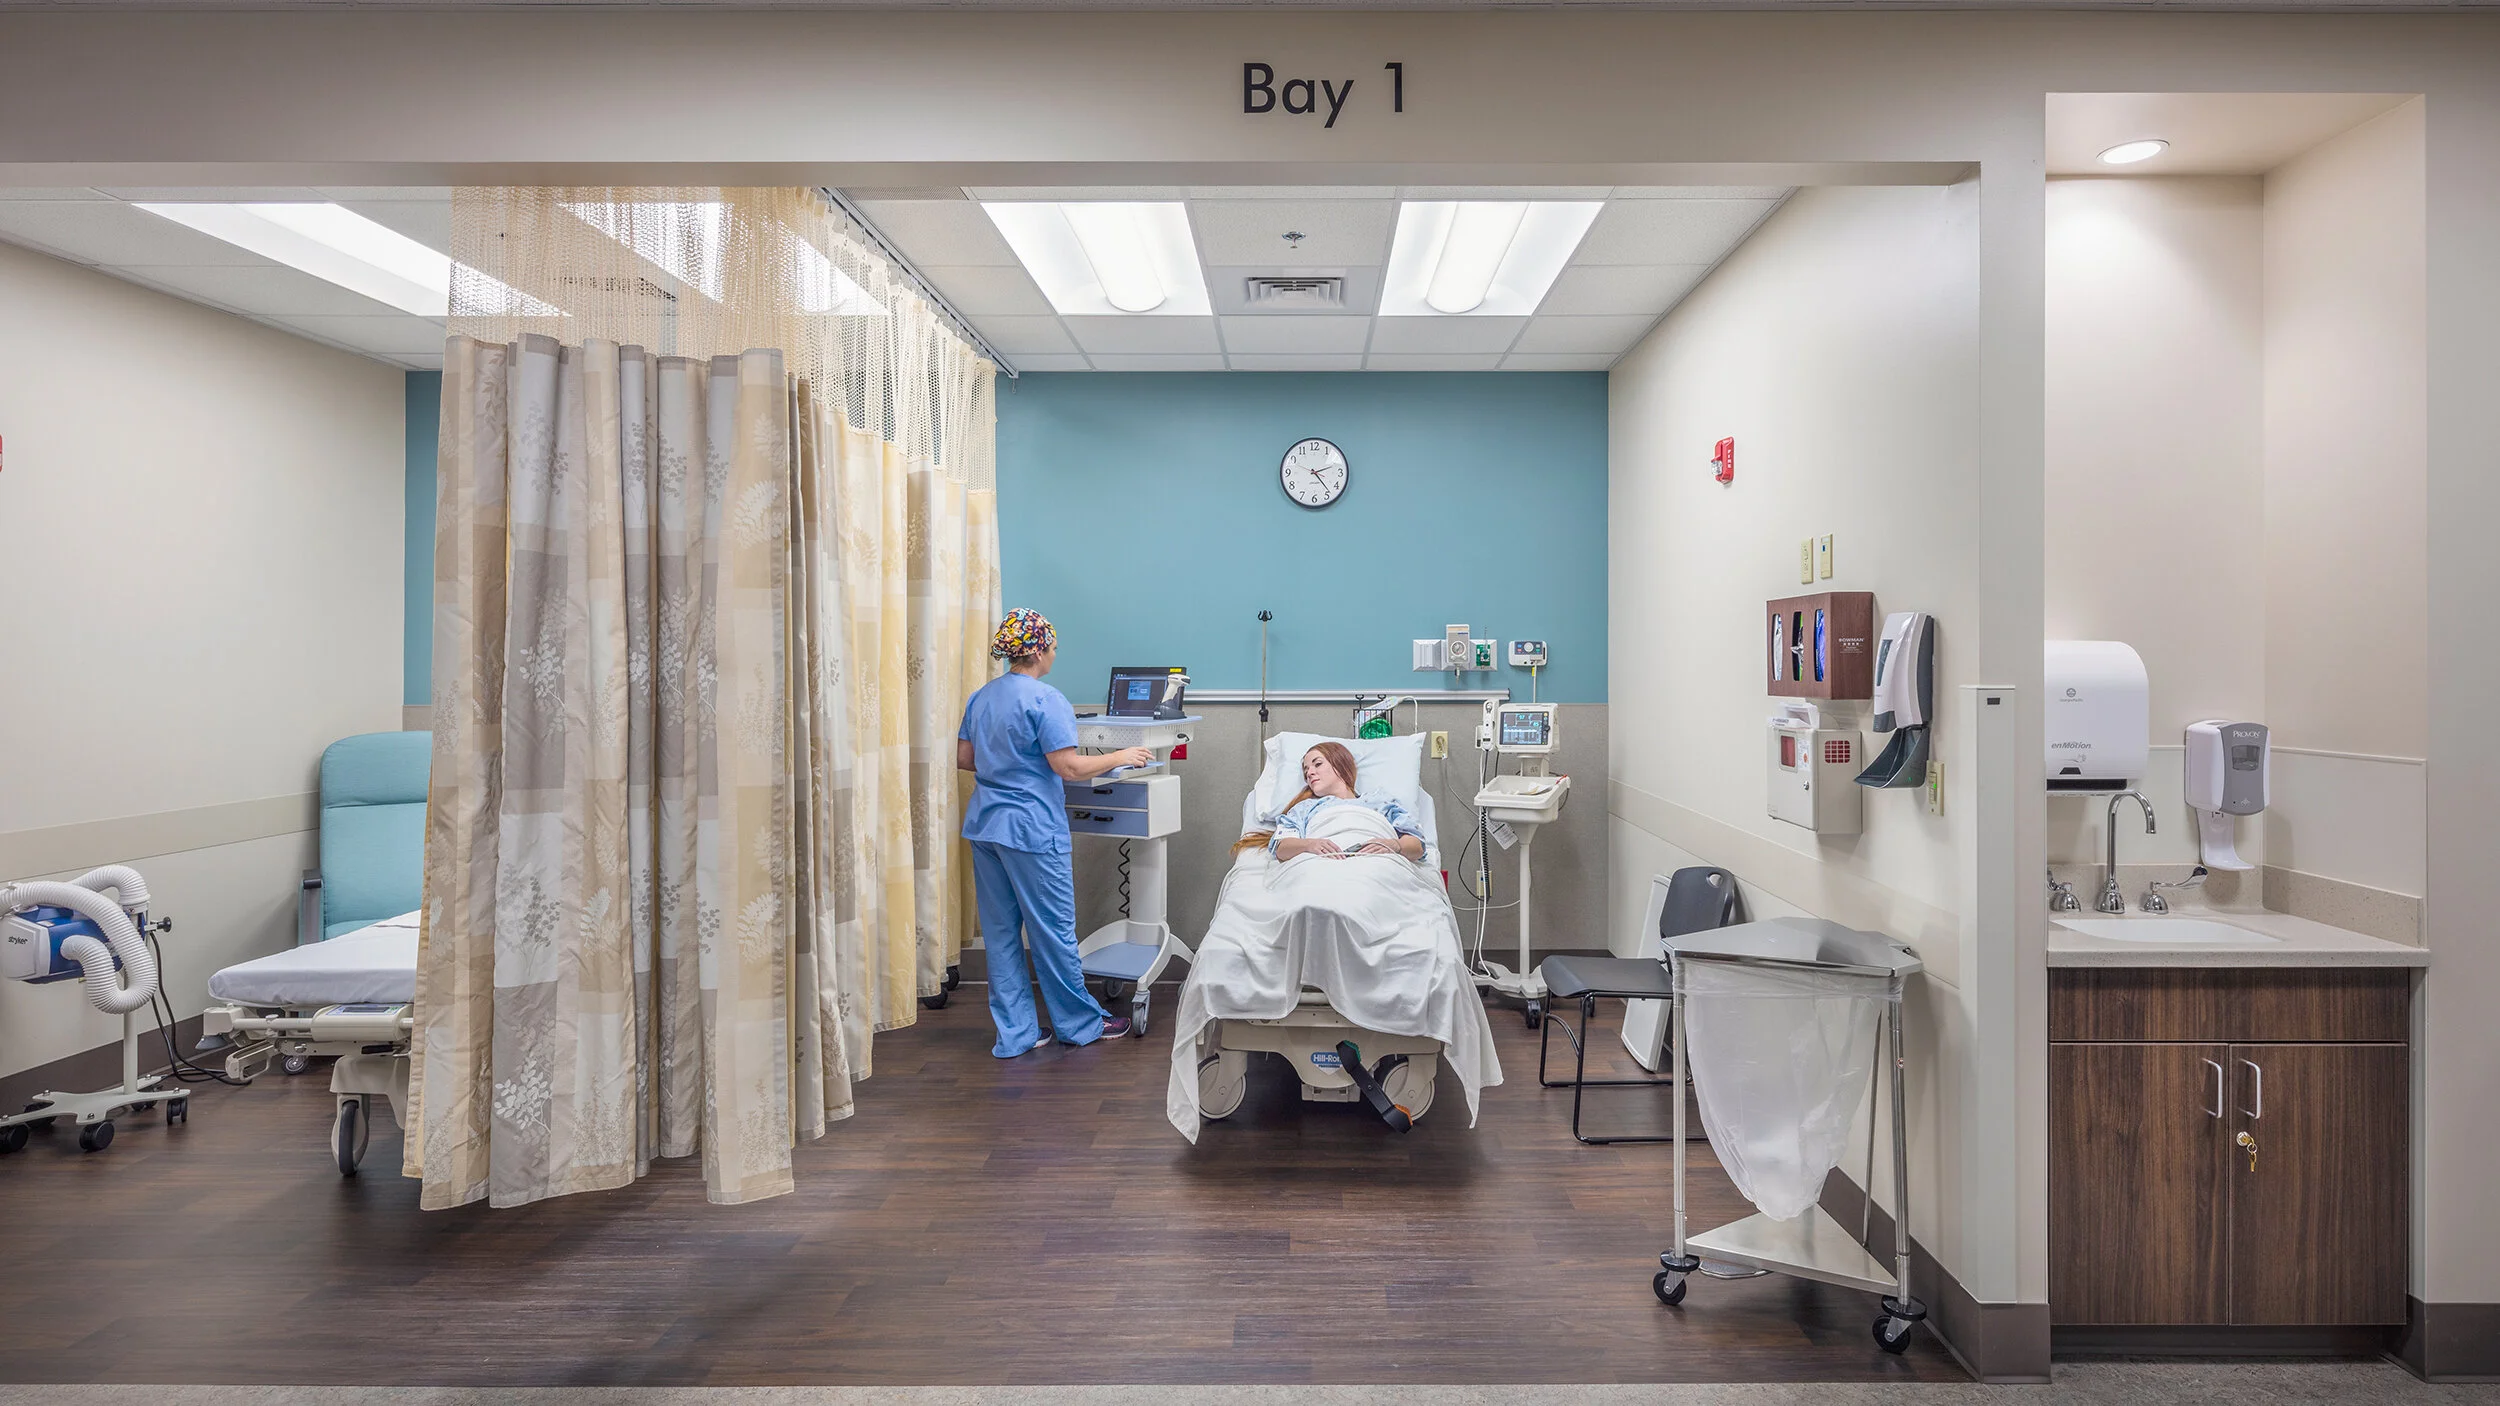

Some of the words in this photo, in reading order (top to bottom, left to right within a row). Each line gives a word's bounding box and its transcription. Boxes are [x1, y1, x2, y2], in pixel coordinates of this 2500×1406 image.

[1243, 62, 1355, 128] Bay
[1384, 62, 1404, 113] 1
[1299, 446, 1306, 455] 11
[1310, 441, 1320, 451] 12
[1325, 446, 1329, 455] 1
[1285, 468, 1292, 478] 9
[1337, 468, 1344, 477] 3
[1288, 480, 1295, 490] 8
[1333, 481, 1340, 490] 4
[1299, 491, 1306, 500] 7
[1311, 494, 1318, 503] 6
[1324, 491, 1330, 500] 5
[2232, 730, 2260, 738] PROVON
[8, 936, 28, 945] stryker
